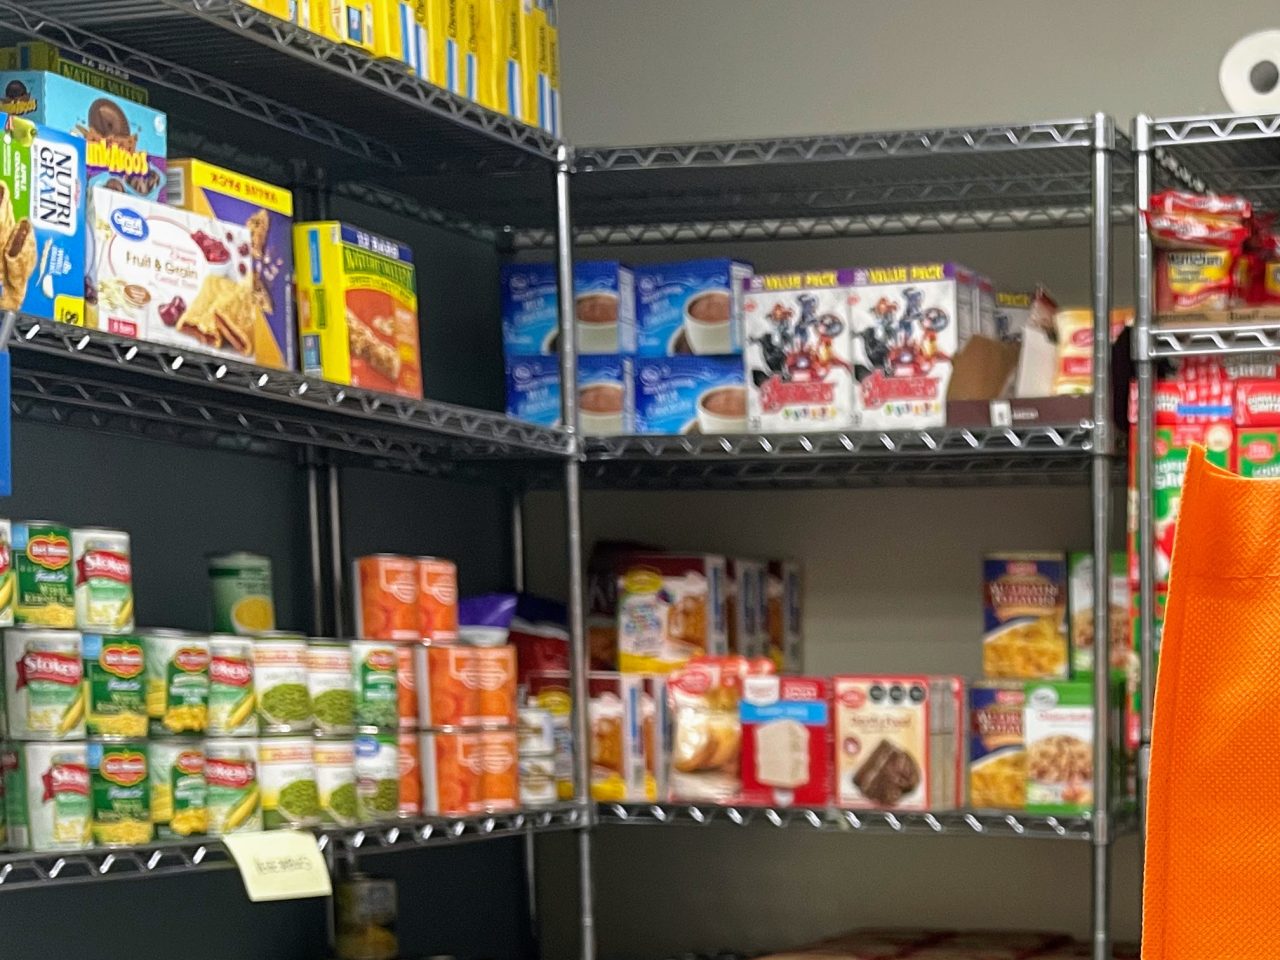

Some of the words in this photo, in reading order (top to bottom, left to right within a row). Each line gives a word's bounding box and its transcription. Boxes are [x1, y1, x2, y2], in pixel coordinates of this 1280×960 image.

[38, 146, 57, 224] GRAIN
[53, 150, 73, 228] NUTRI
[126, 251, 152, 268] Fruit
[165, 261, 198, 281] Grain
[870, 267, 907, 284] VALUE
[764, 274, 801, 290] VALUE
